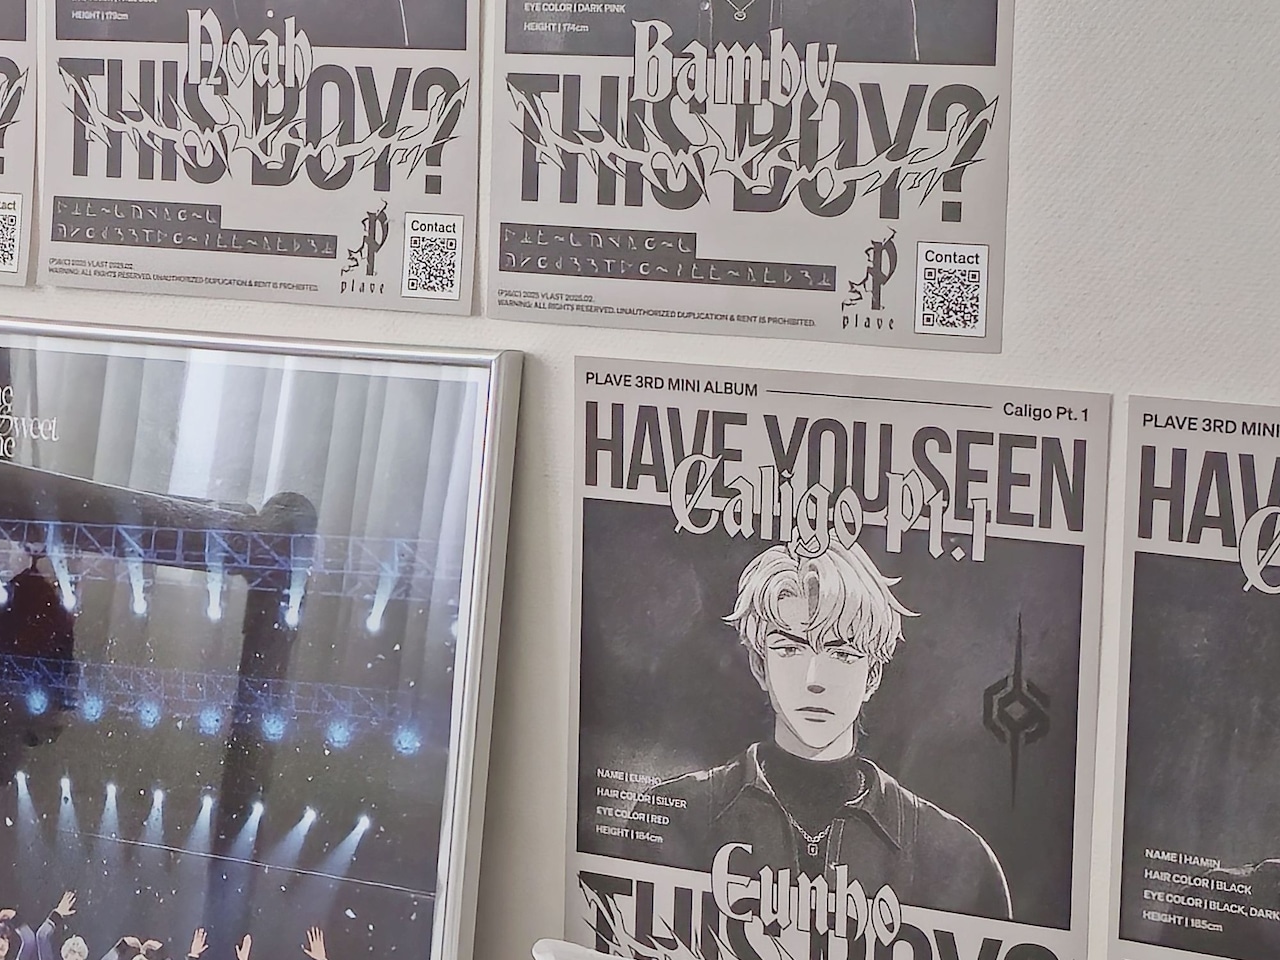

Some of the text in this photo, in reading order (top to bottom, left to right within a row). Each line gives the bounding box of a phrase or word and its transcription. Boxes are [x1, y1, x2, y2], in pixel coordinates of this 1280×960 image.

[524, 2, 541, 12] EYE
[542, 2, 573, 12] COLOR
[577, 3, 603, 13] DARK
[604, 3, 626, 14] PINK
[523, 21, 557, 32] HEIGHT
[631, 20, 837, 121] Bamby
[410, 219, 457, 234] Contact
[924, 249, 981, 265] Contact
[540, 292, 565, 301] VLAST
[533, 301, 547, 310] ALL
[547, 302, 575, 312] RIGHTS
[677, 310, 729, 321] DUPLICATION
[736, 314, 758, 323] RENT
[585, 371, 759, 397] PLAVE 3RD MINI ALBUM
[1002, 401, 1053, 423] Caligo
[1142, 412, 1198, 431] PLAVE
[1201, 417, 1237, 434] 3RD
[584, 399, 1087, 532] HAVE YOU SEEN
[669, 453, 864, 559] Caligo
[596, 768, 625, 781] NAME
[596, 787, 619, 799] HAIR
[620, 790, 651, 804] COLOR
[656, 795, 687, 809] SILVER
[596, 805, 614, 817] EYE
[614, 808, 646, 822] COLOR
[650, 814, 670, 825] RED
[595, 824, 630, 838] HEIGHT
[1145, 848, 1178, 863] NAME
[1183, 854, 1221, 870] HAMIN
[1144, 868, 1171, 882] HAIR
[1171, 873, 1210, 890] COLOR
[1216, 880, 1253, 896] BLACK
[710, 841, 901, 947] Eunho
[1143, 889, 1166, 903] EYE
[1165, 893, 1203, 909] COLOR
[1208, 900, 1249, 917] BLACK,
[1249, 906, 1280, 921] DARK
[1142, 909, 1185, 926] HEIGHT
